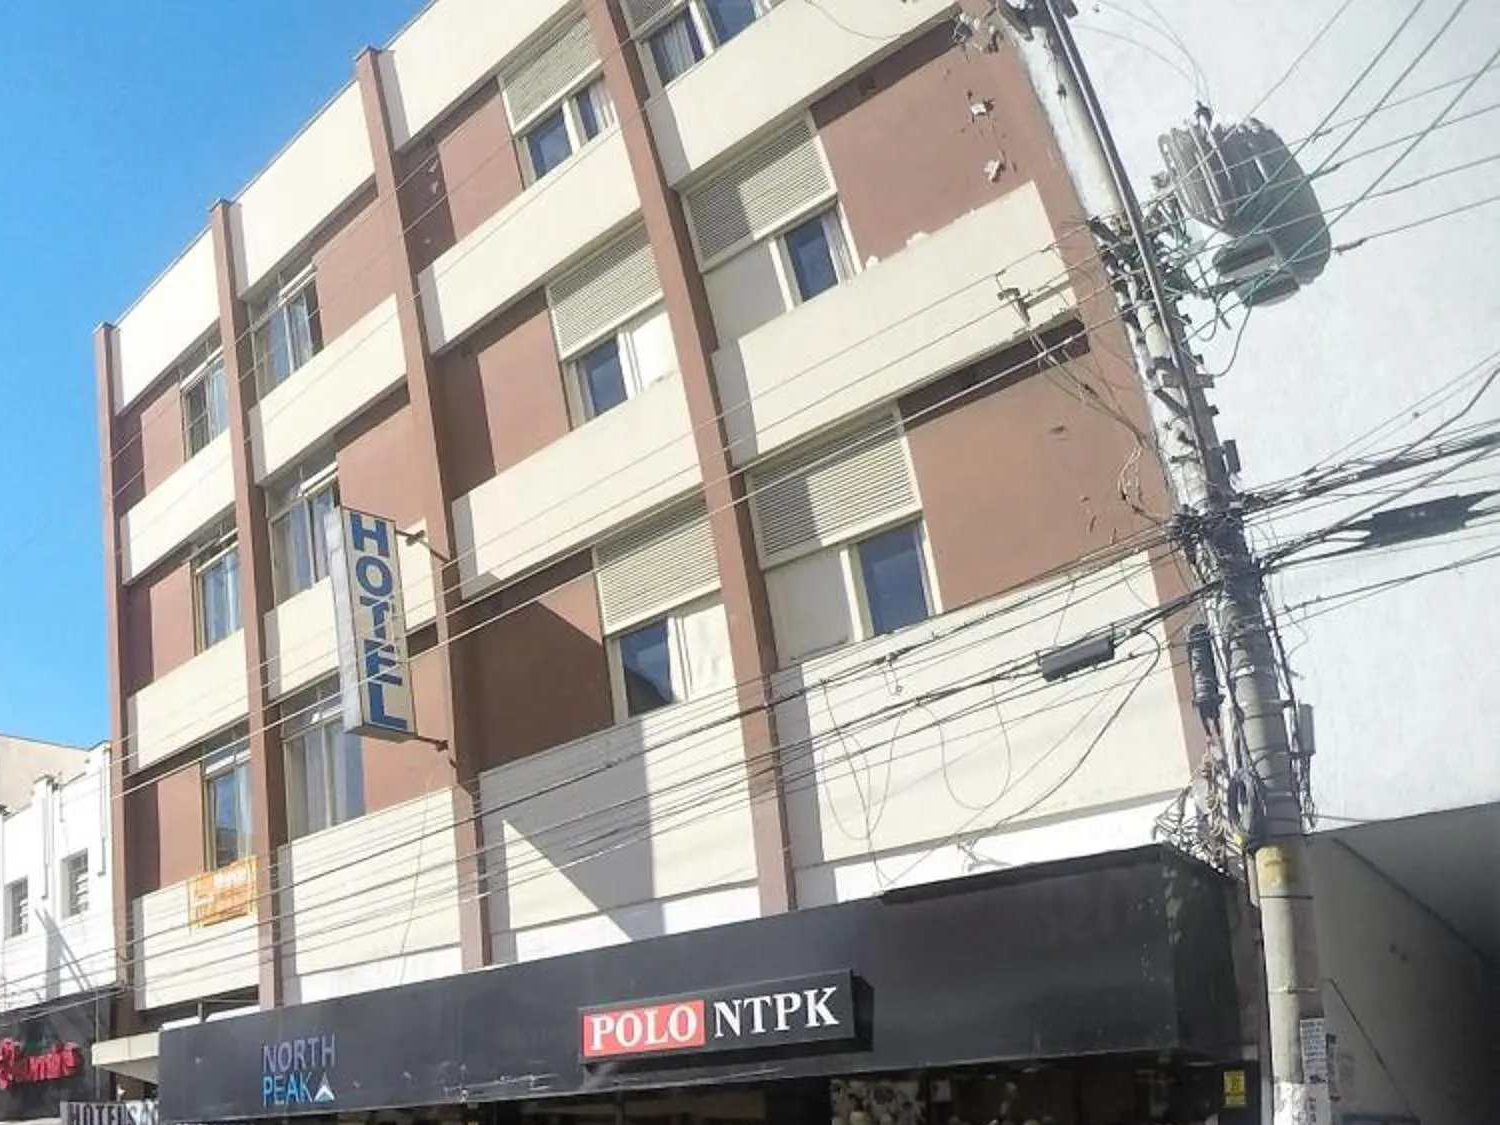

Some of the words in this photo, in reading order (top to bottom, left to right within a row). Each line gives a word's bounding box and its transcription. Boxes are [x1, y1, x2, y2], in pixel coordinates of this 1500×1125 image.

[350, 511, 408, 733] HOTEL
[591, 1004, 698, 1051] POLO
[713, 986, 841, 1039] NTPK
[263, 1031, 335, 1074] NORTH
[263, 1071, 313, 1107] PEAK
